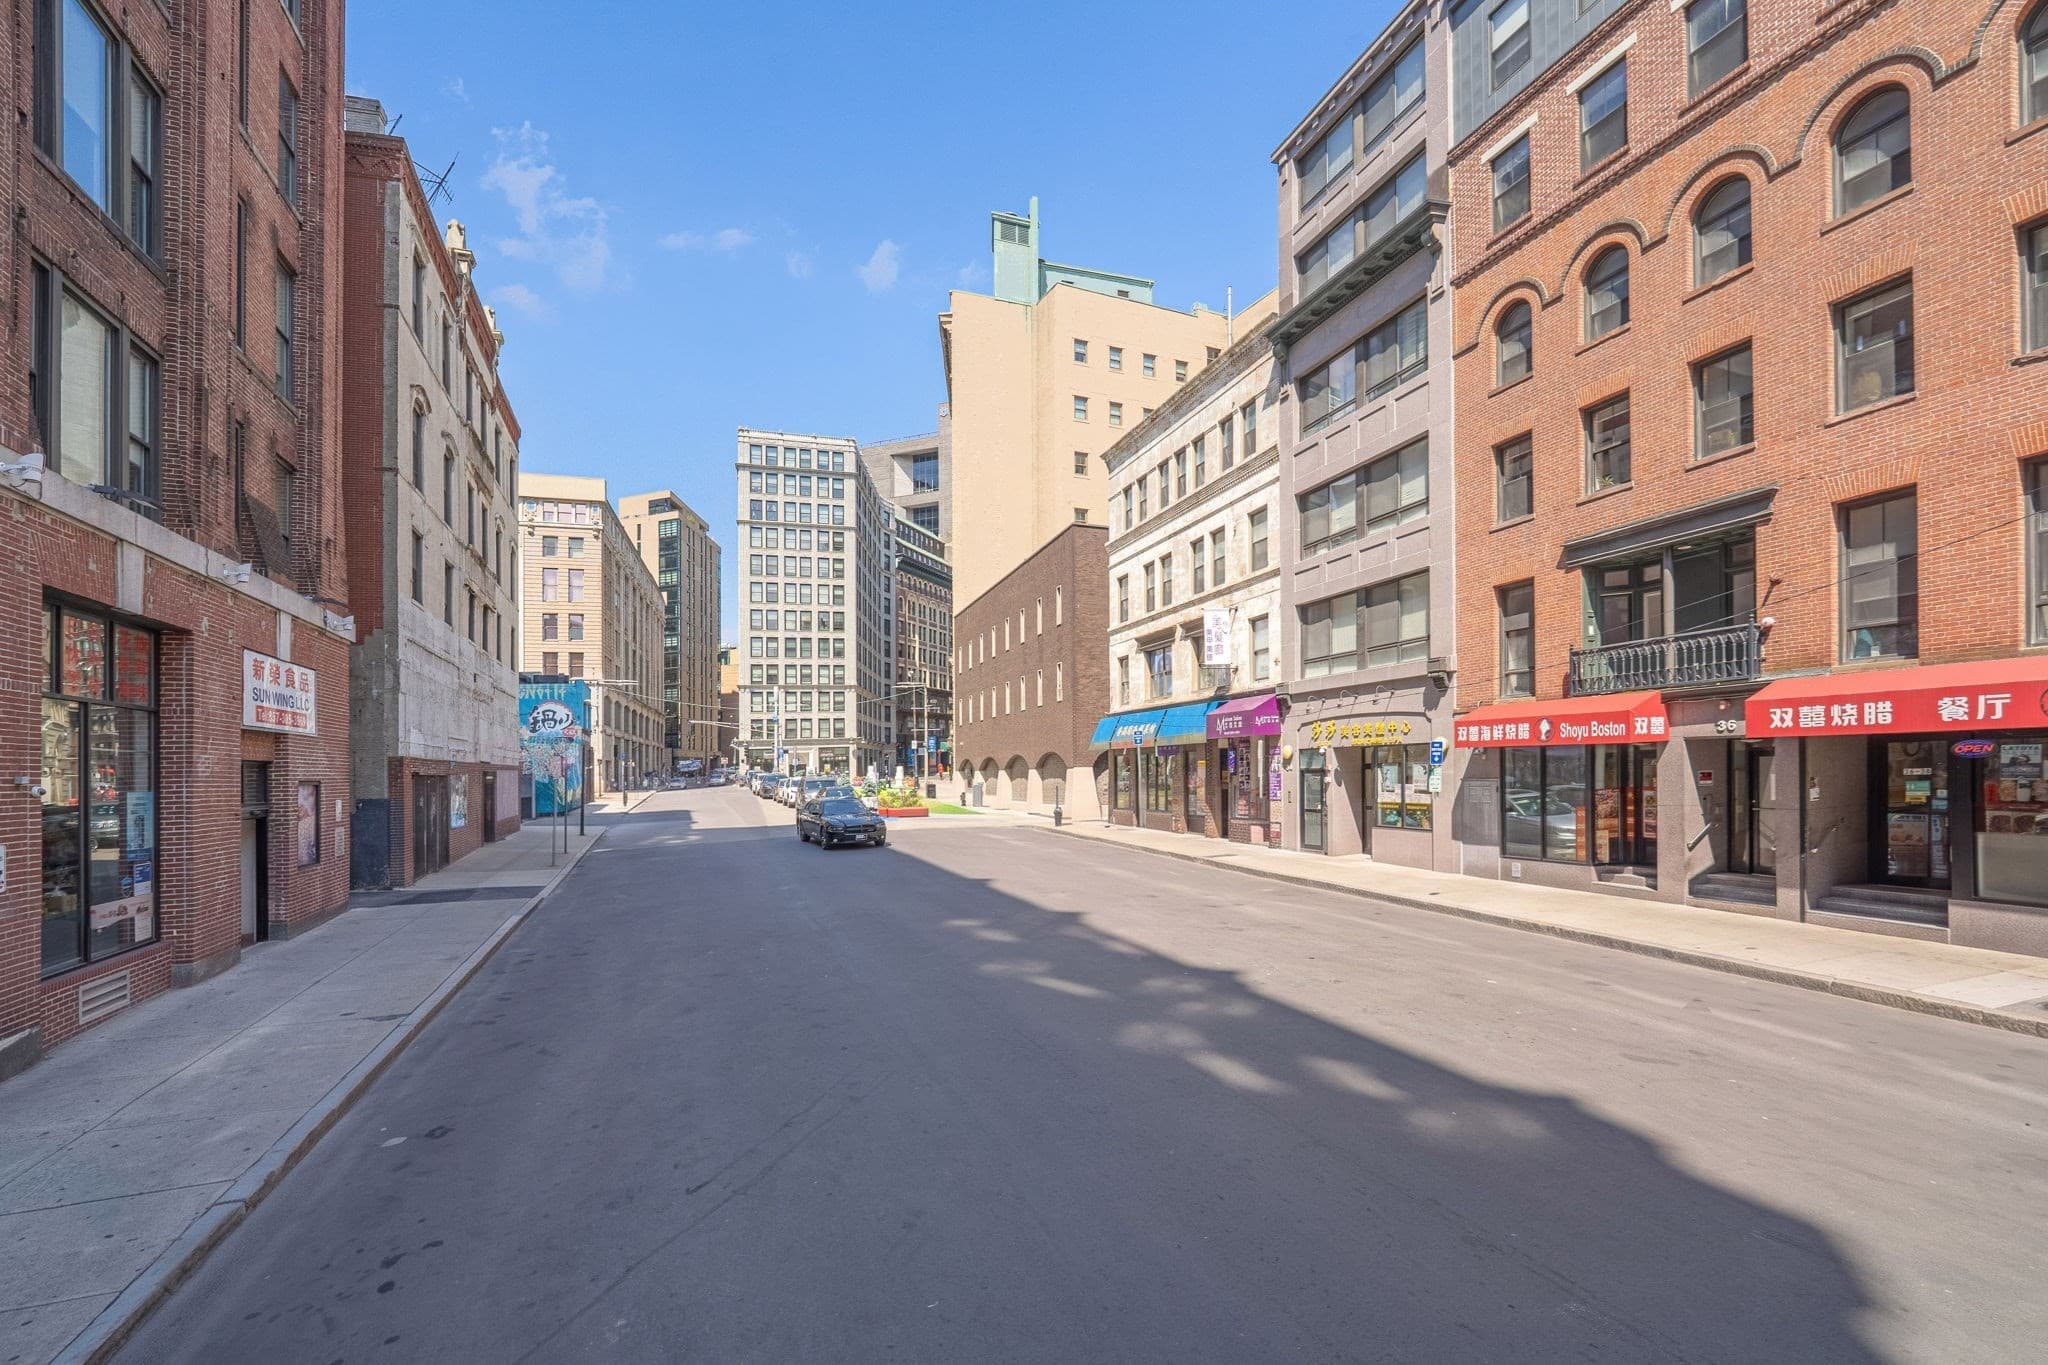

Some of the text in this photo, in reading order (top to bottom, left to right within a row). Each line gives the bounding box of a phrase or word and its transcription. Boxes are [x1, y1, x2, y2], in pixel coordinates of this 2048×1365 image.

[252, 657, 309, 693] 新榮食品
[252, 686, 310, 712] SUN WING LLC
[1769, 693, 2012, 729] 双囍烧腊 餐厅
[1560, 721, 1626, 741] Shoyu Boston
[1717, 720, 1737, 732] 36
[1954, 743, 1994, 754] OPEN
